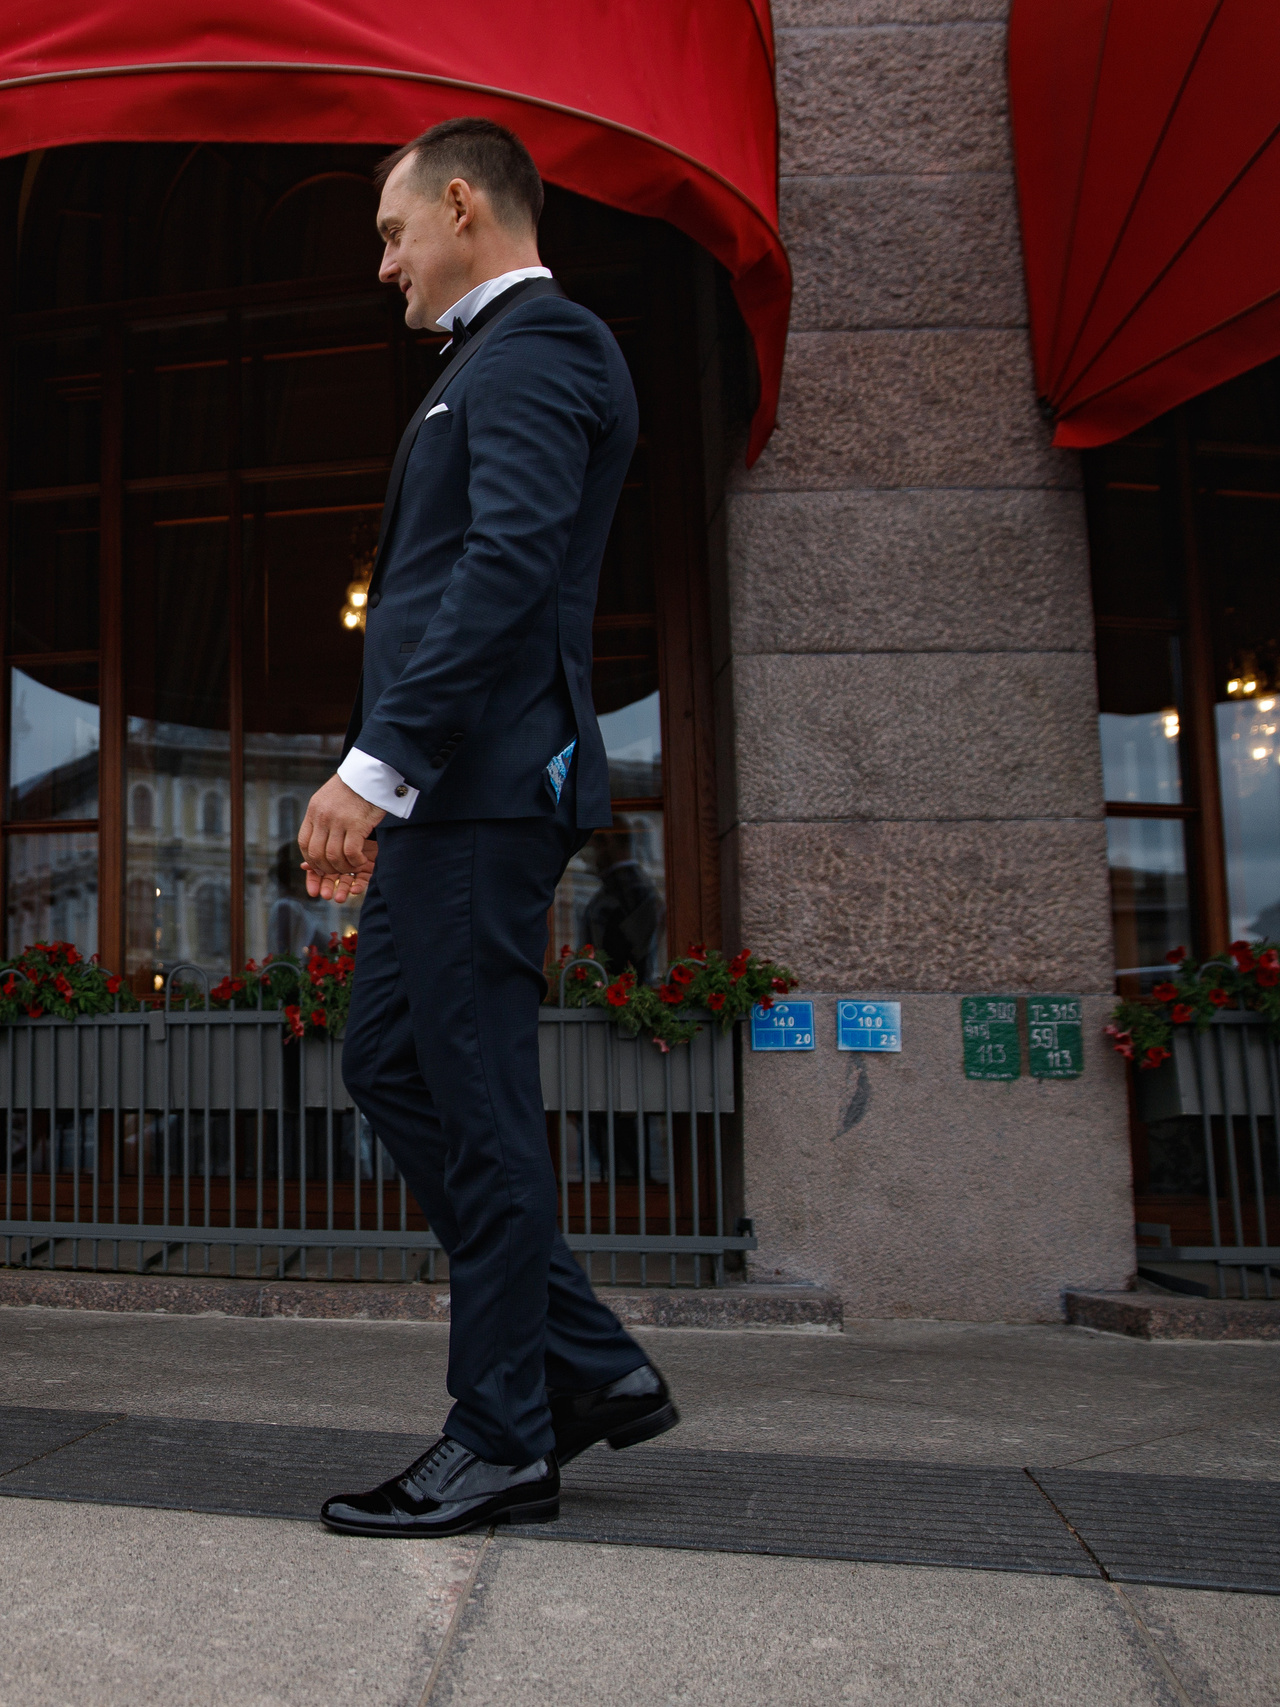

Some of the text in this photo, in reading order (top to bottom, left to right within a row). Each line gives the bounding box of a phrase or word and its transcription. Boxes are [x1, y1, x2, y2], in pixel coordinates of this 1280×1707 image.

[773, 1016, 795, 1028] 14.0
[975, 1043, 1007, 1064] 113
[1046, 1050, 1073, 1068] 113
